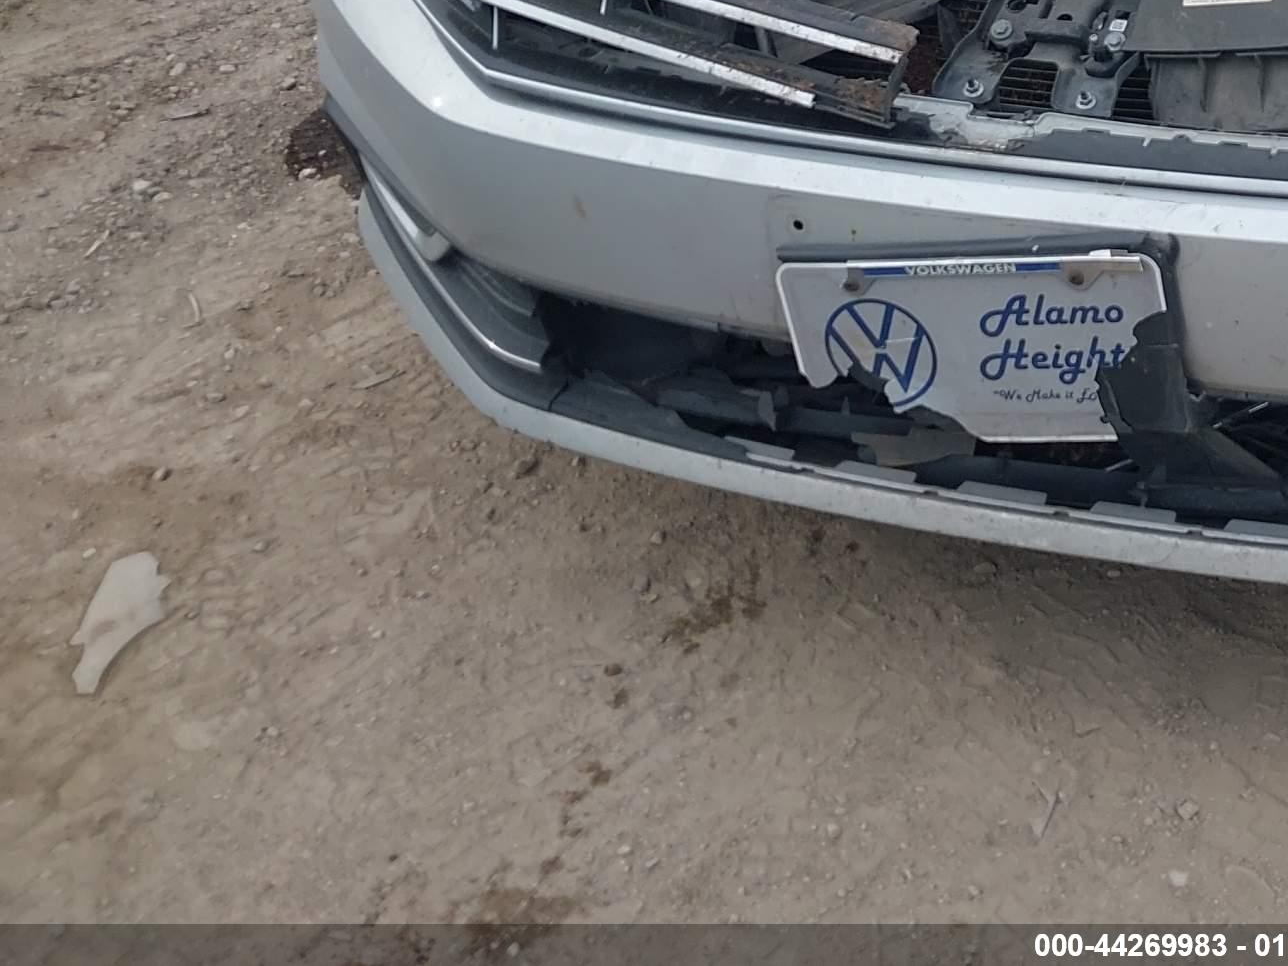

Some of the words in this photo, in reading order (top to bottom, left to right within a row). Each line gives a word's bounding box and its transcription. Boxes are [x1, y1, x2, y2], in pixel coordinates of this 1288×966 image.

[904, 262, 1017, 276] VOLKSWAGEN
[979, 294, 1124, 337] Alamo
[1025, 388, 1061, 403] Make
[1065, 390, 1074, 400] it
